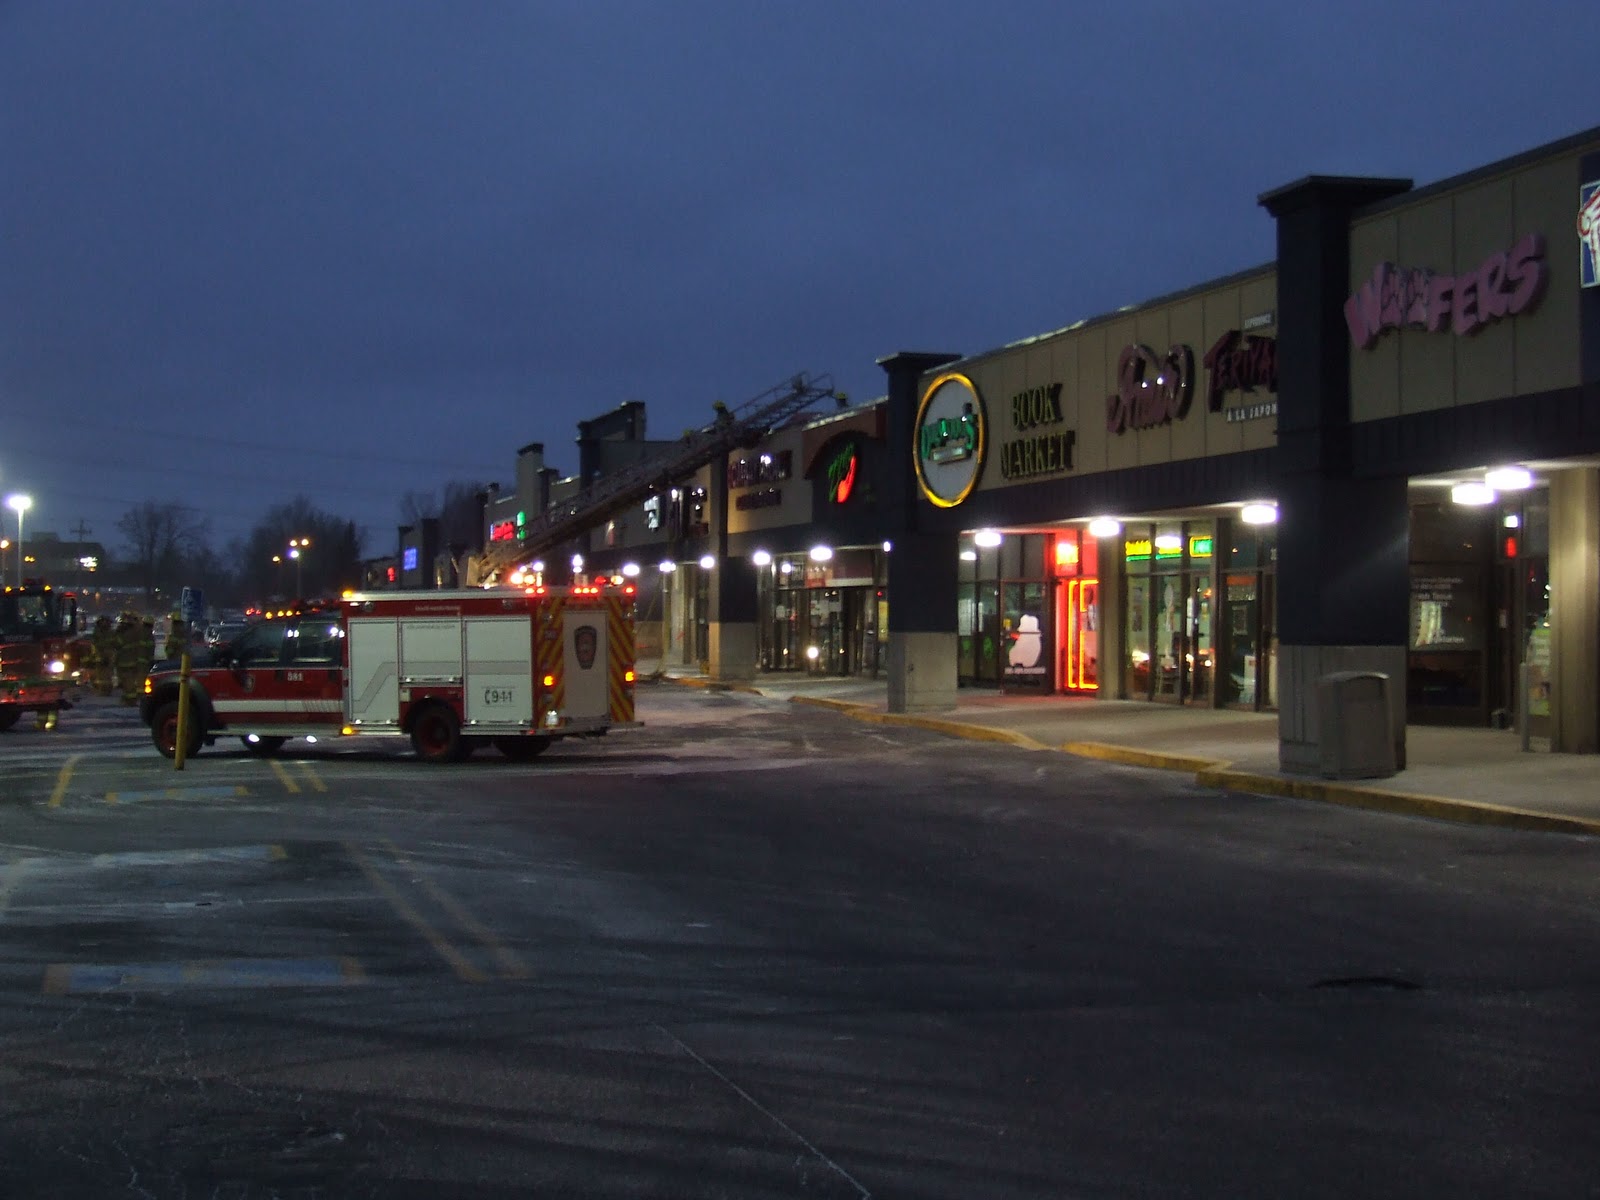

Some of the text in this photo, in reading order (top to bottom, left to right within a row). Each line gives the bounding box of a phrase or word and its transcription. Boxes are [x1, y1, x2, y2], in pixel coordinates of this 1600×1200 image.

[1203, 331, 1278, 412] TERIYA
[1011, 384, 1063, 432] BOOK
[1000, 430, 1075, 480] MARKET
